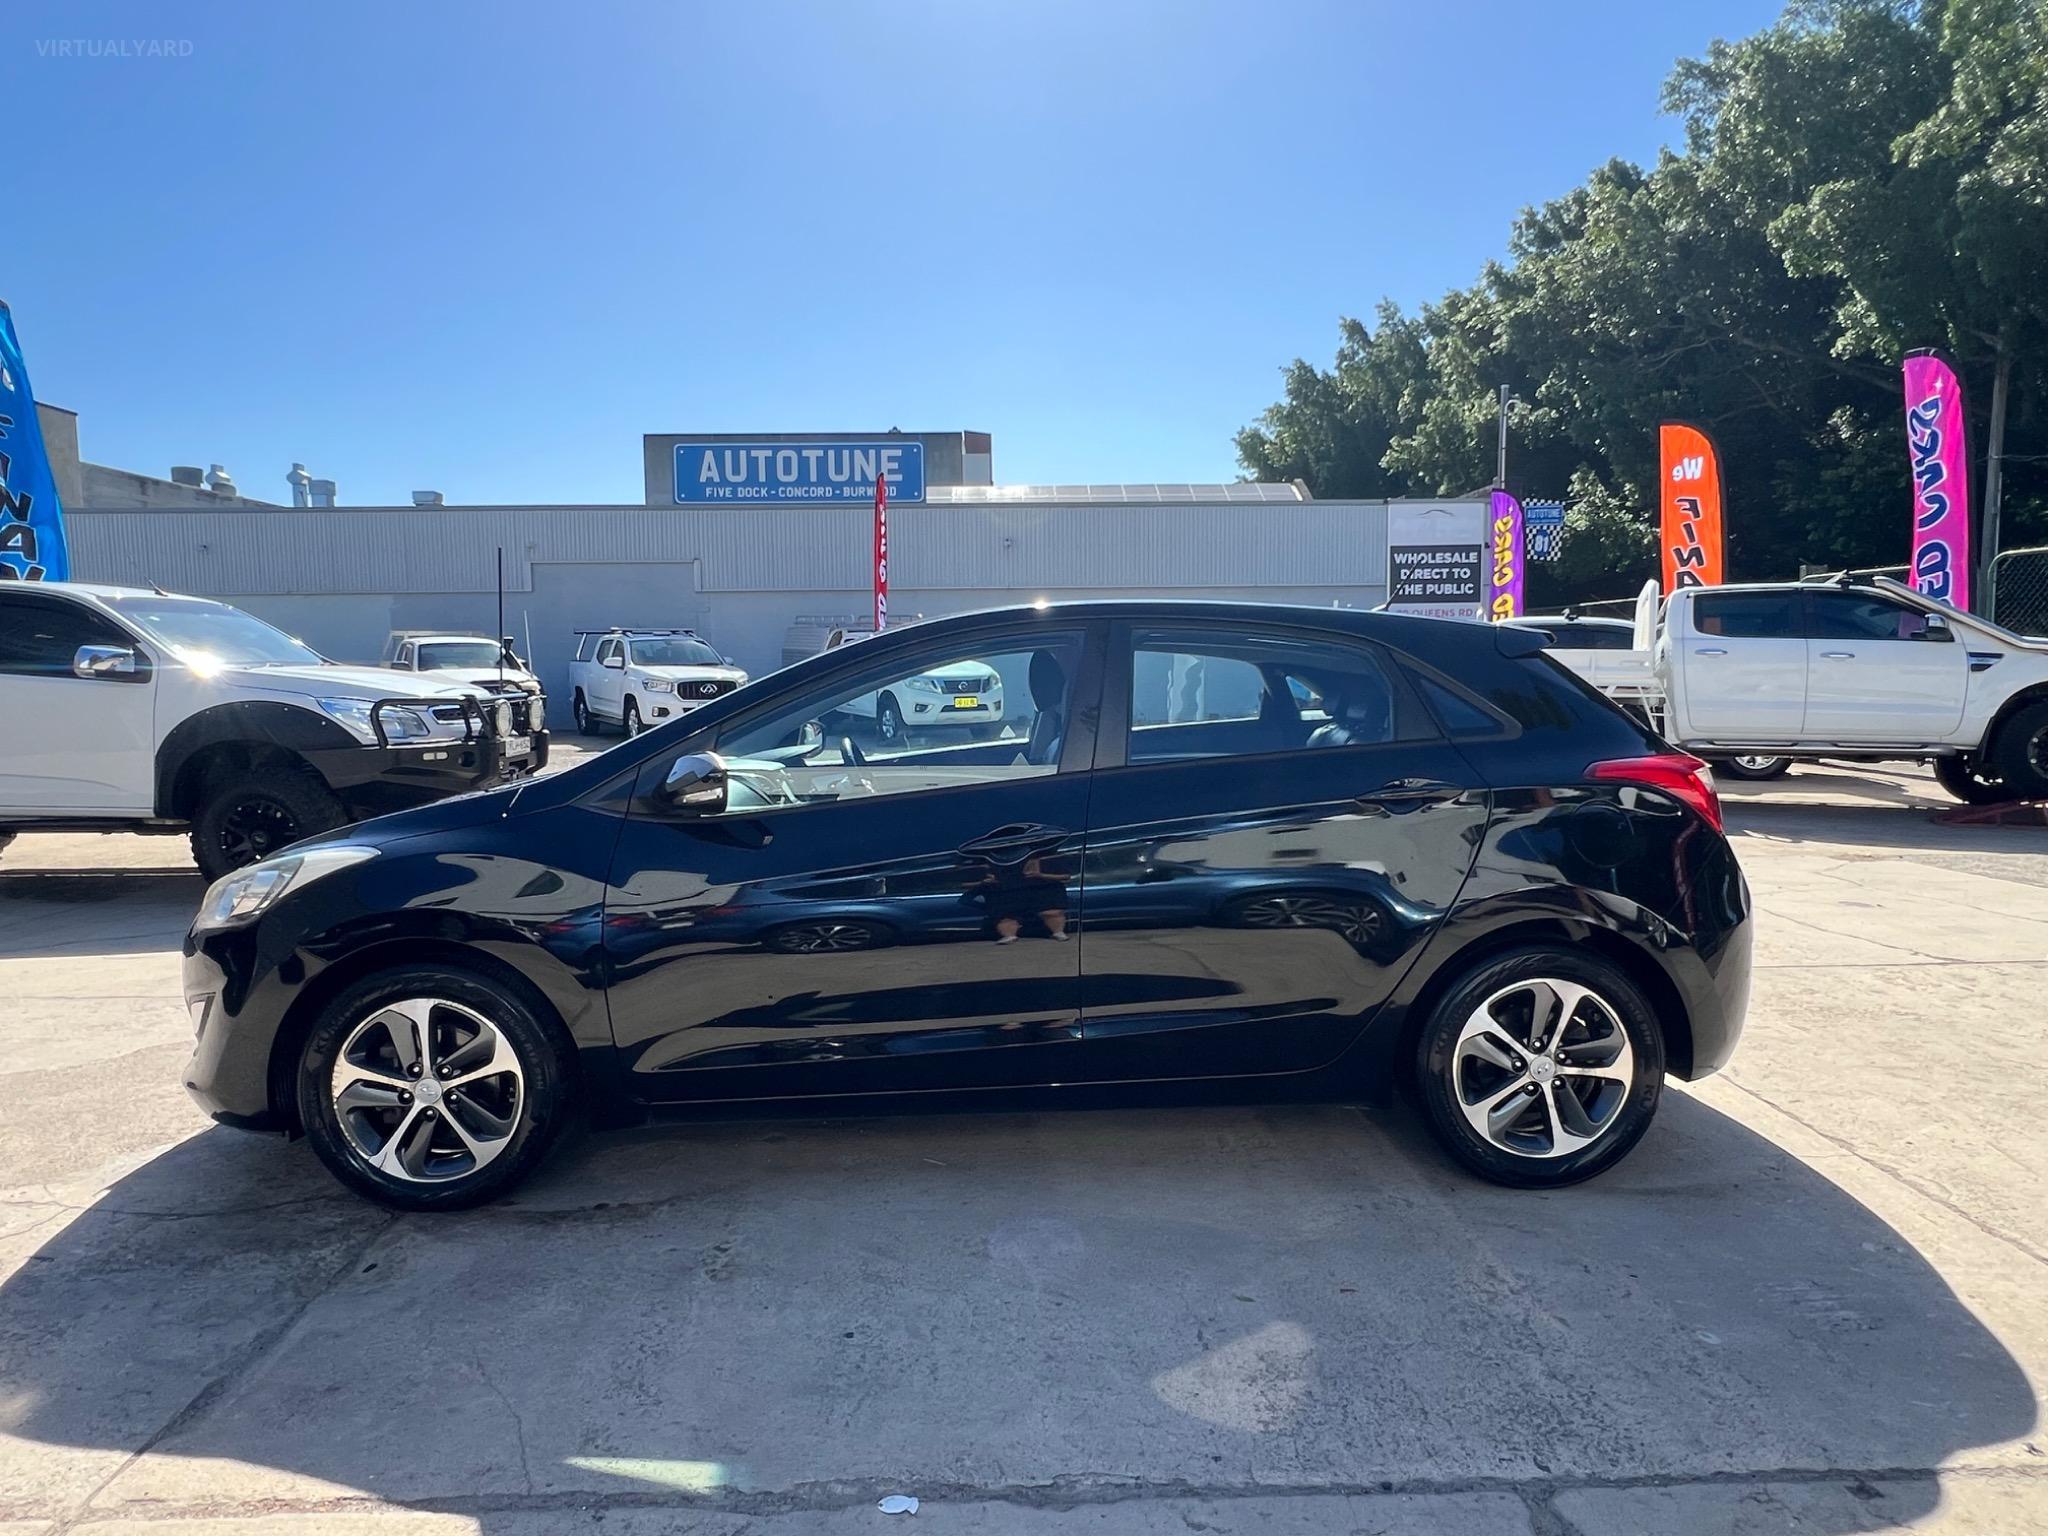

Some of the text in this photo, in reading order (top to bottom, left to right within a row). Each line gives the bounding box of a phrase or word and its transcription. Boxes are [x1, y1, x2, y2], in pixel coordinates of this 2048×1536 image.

[699, 449, 903, 483] AUTOTUNE
[706, 487, 733, 498] FIVE
[738, 487, 768, 498] DOCK
[779, 486, 833, 498] CONCORD
[843, 486, 896, 498] BURWOD
[1394, 552, 1478, 564] WHOLESALE
[1452, 568, 1471, 579] TO
[1426, 583, 1474, 595] PUBLIC
